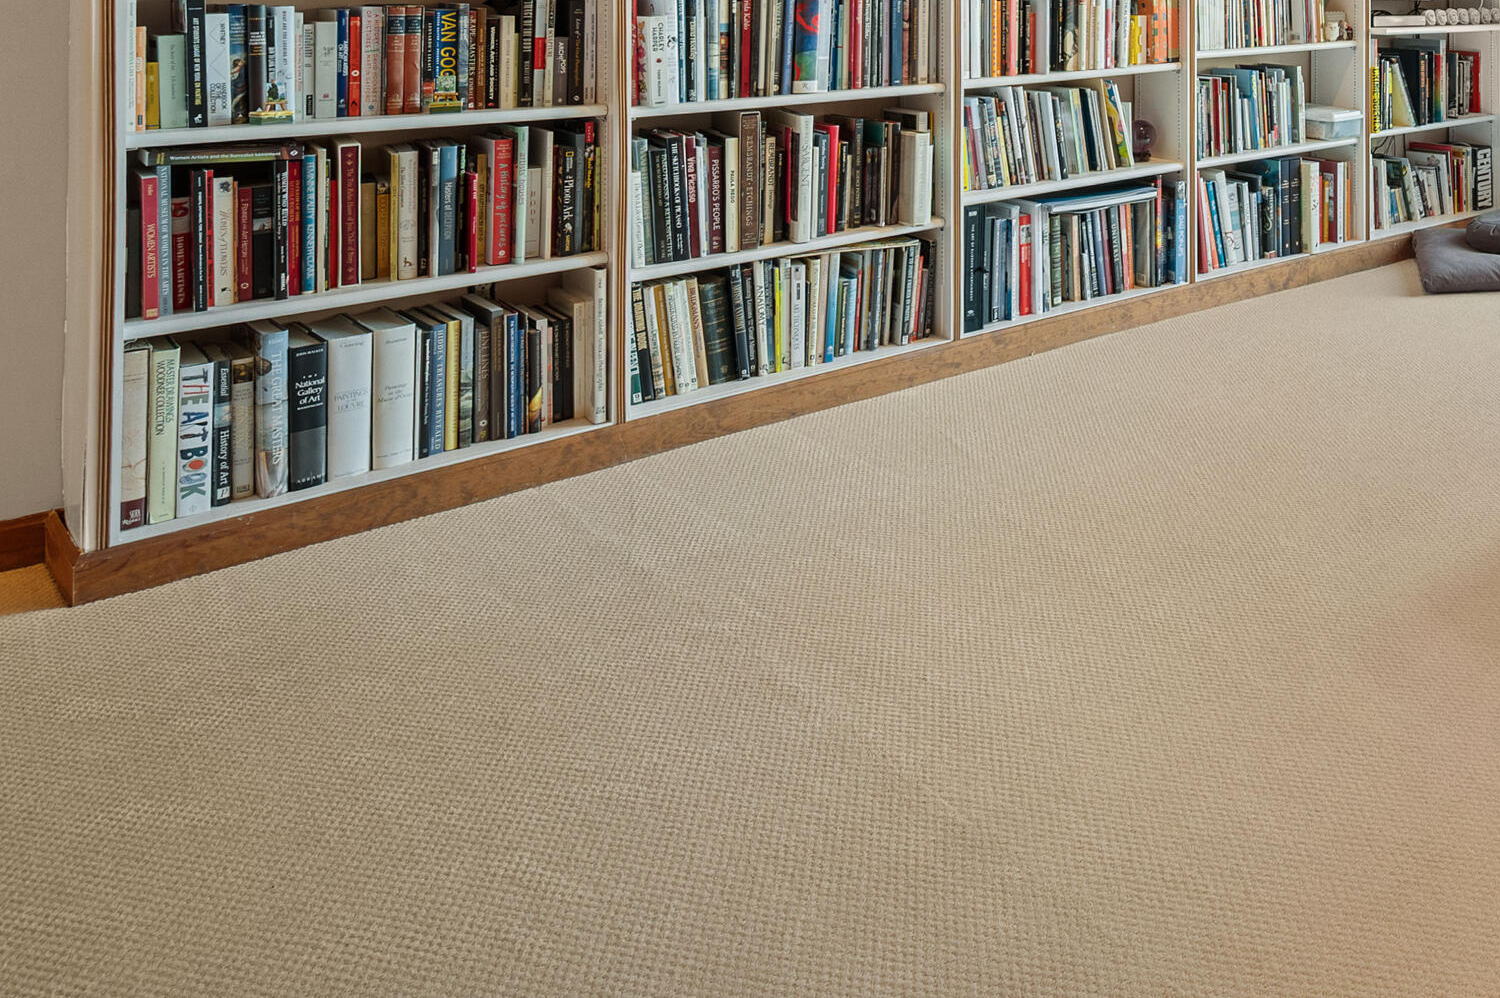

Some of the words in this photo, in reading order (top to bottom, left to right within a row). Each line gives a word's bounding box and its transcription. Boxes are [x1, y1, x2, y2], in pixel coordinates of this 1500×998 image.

[440, 11, 457, 42] VAN
[657, 22, 665, 51] CHARLEY
[743, 13, 751, 31] Kahlo
[440, 46, 457, 76] GOG
[468, 43, 476, 76] MASTERS
[711, 159, 720, 201] PISSARRO'S
[767, 142, 775, 187] REMBRANDT
[800, 145, 811, 189] SARGENT
[1477, 148, 1492, 207] CENTURY
[161, 166, 169, 196] NATIONAL
[562, 179, 574, 204] Photo
[687, 173, 697, 203] Picasso
[562, 204, 574, 221] Ark
[712, 202, 721, 231] PEOPLE
[146, 223, 156, 251] WOMEN
[177, 236, 185, 269] WOMEN
[1110, 223, 1120, 263] UNIVERSE
[146, 252, 156, 278] ARTISTS
[690, 287, 700, 330] BRIDGMAN'S
[756, 284, 765, 326] ANATOMY
[436, 329, 444, 361] HIDDEN
[165, 359, 175, 384] MASTER
[271, 351, 282, 376] THE
[181, 368, 209, 406] THE
[219, 368, 230, 397] Essential
[271, 377, 282, 412] GREAT
[295, 376, 326, 390] National
[296, 386, 324, 398] Gallery
[435, 363, 443, 407] TREASURES
[165, 385, 174, 423] DRAWINGS
[299, 396, 307, 405] of
[306, 395, 321, 405] Art
[155, 396, 165, 436] COLLECTION
[180, 411, 209, 442] ART
[434, 409, 443, 450] REVEALED
[217, 430, 229, 462] History
[271, 414, 283, 465] MASTERS
[180, 445, 209, 500] BOOK
[219, 462, 229, 470] of
[219, 470, 229, 486] Art
